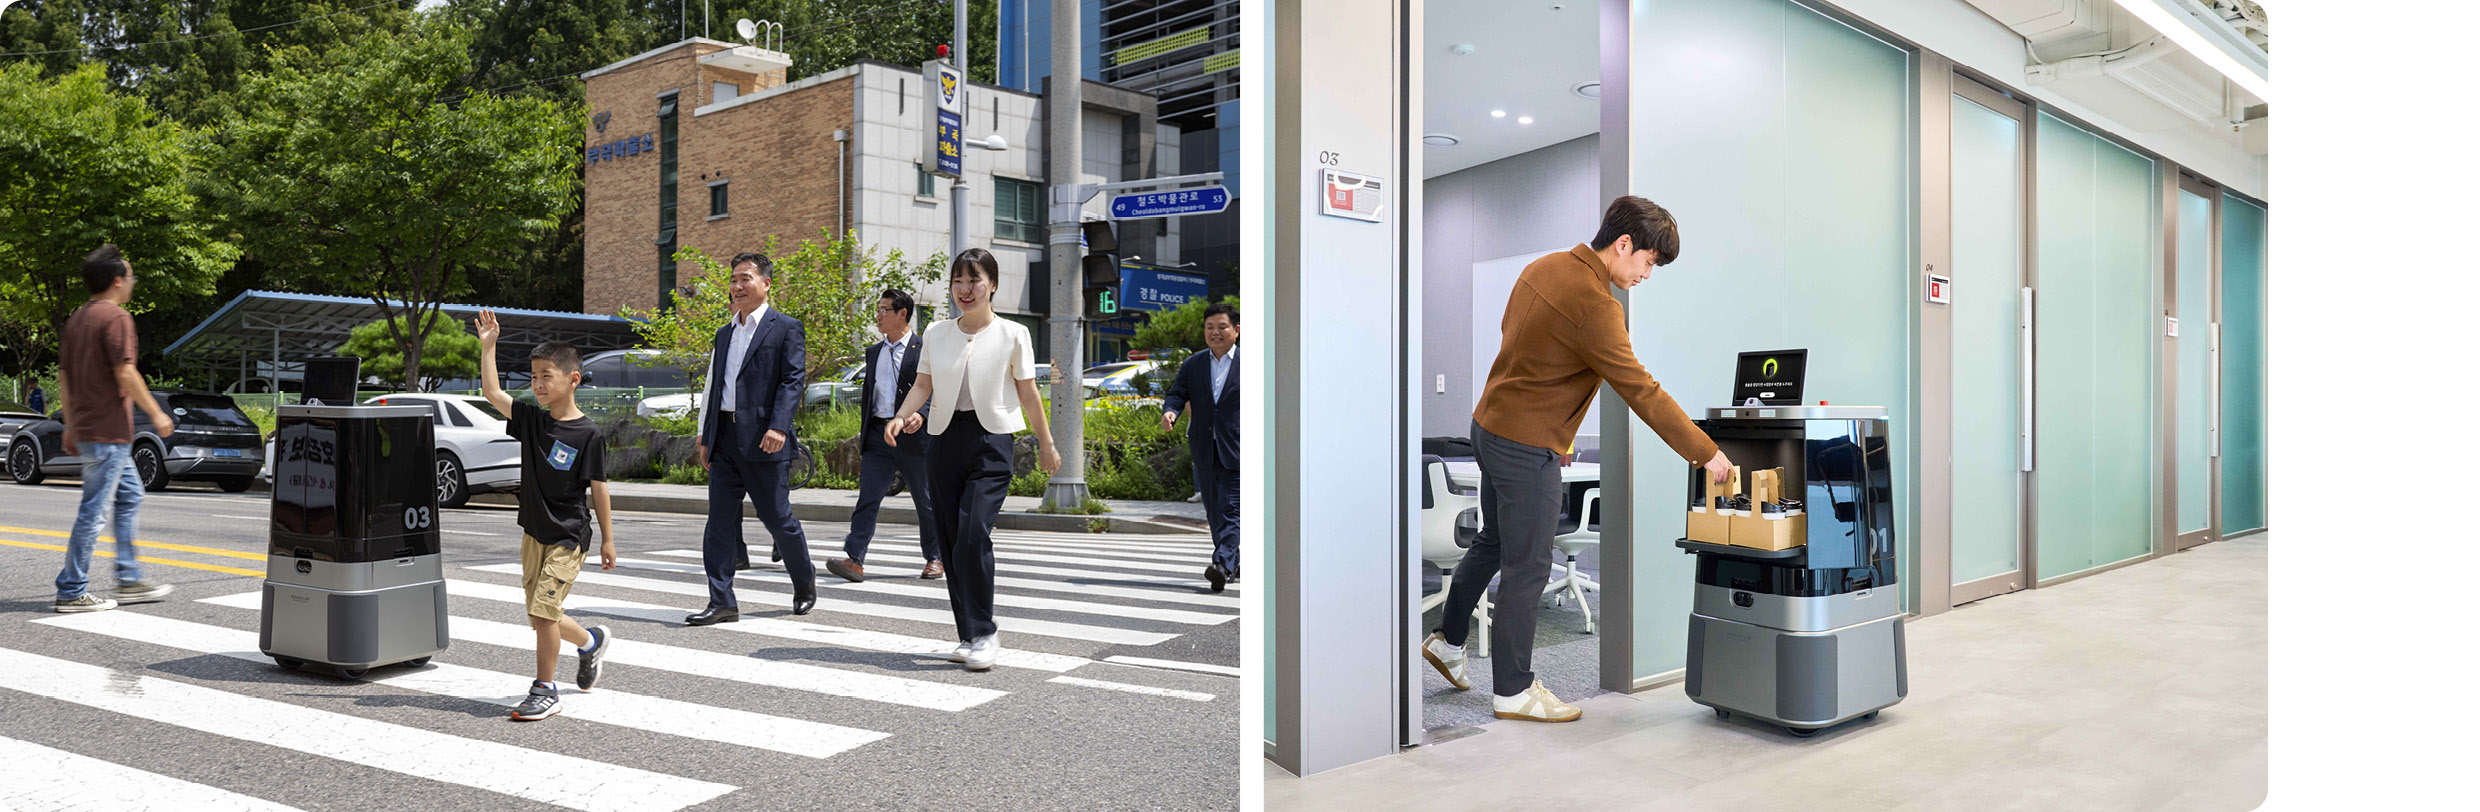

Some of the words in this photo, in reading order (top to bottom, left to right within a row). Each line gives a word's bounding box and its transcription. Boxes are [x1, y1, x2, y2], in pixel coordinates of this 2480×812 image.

[587, 134, 654, 165] 부곡파출소
[1319, 150, 1340, 166] 03
[1137, 191, 1199, 207] 철도박물관로
[1212, 195, 1223, 204] 53
[1116, 203, 1126, 212] 49
[1140, 287, 1158, 301] 경찰
[1160, 293, 1184, 304] POLICE
[404, 505, 431, 530] 03
